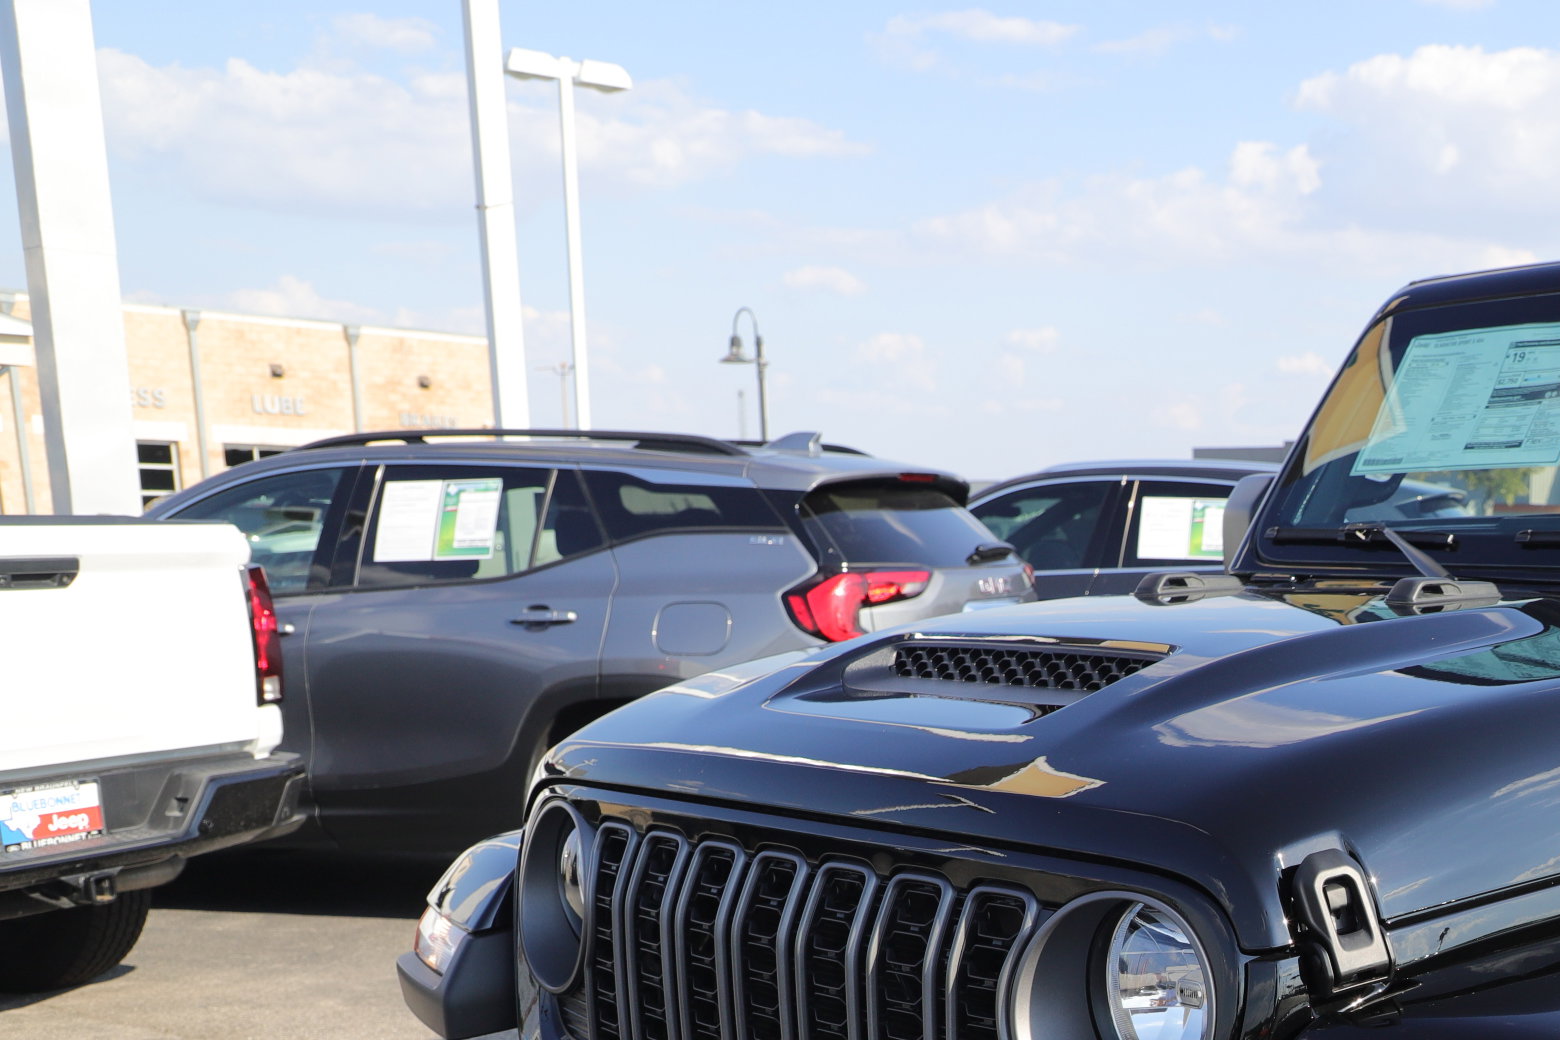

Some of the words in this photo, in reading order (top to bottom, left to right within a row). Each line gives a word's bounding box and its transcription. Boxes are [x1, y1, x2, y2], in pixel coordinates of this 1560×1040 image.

[1511, 351, 1527, 363] 19
[251, 393, 306, 416] LUBE
[47, 813, 90, 832] Jeep
